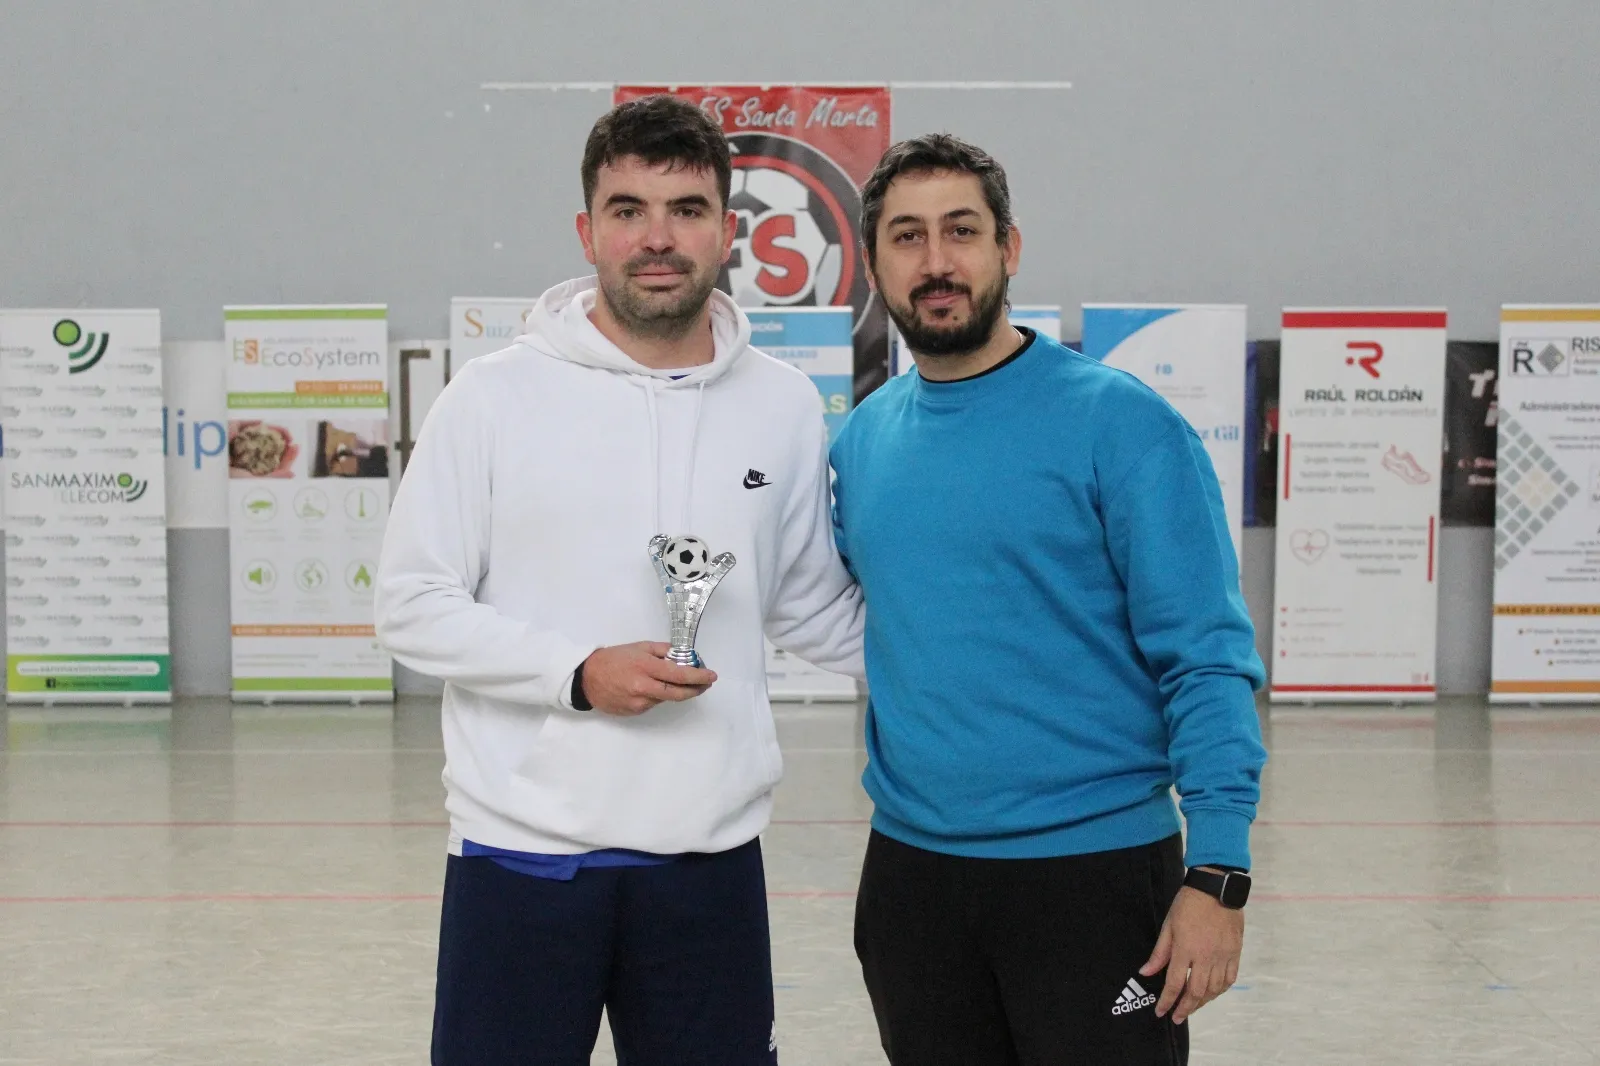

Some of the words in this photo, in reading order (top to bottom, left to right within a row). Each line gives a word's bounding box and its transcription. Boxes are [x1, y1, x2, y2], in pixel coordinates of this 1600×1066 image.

[735, 96, 797, 128] Santa
[805, 96, 878, 129] Marta
[262, 347, 380, 370] EcoSystem
[1305, 384, 1346, 401] RAÚL
[1355, 384, 1423, 401] ROLDÁN
[747, 468, 766, 484] NIKE
[1111, 993, 1156, 1015] adidas
